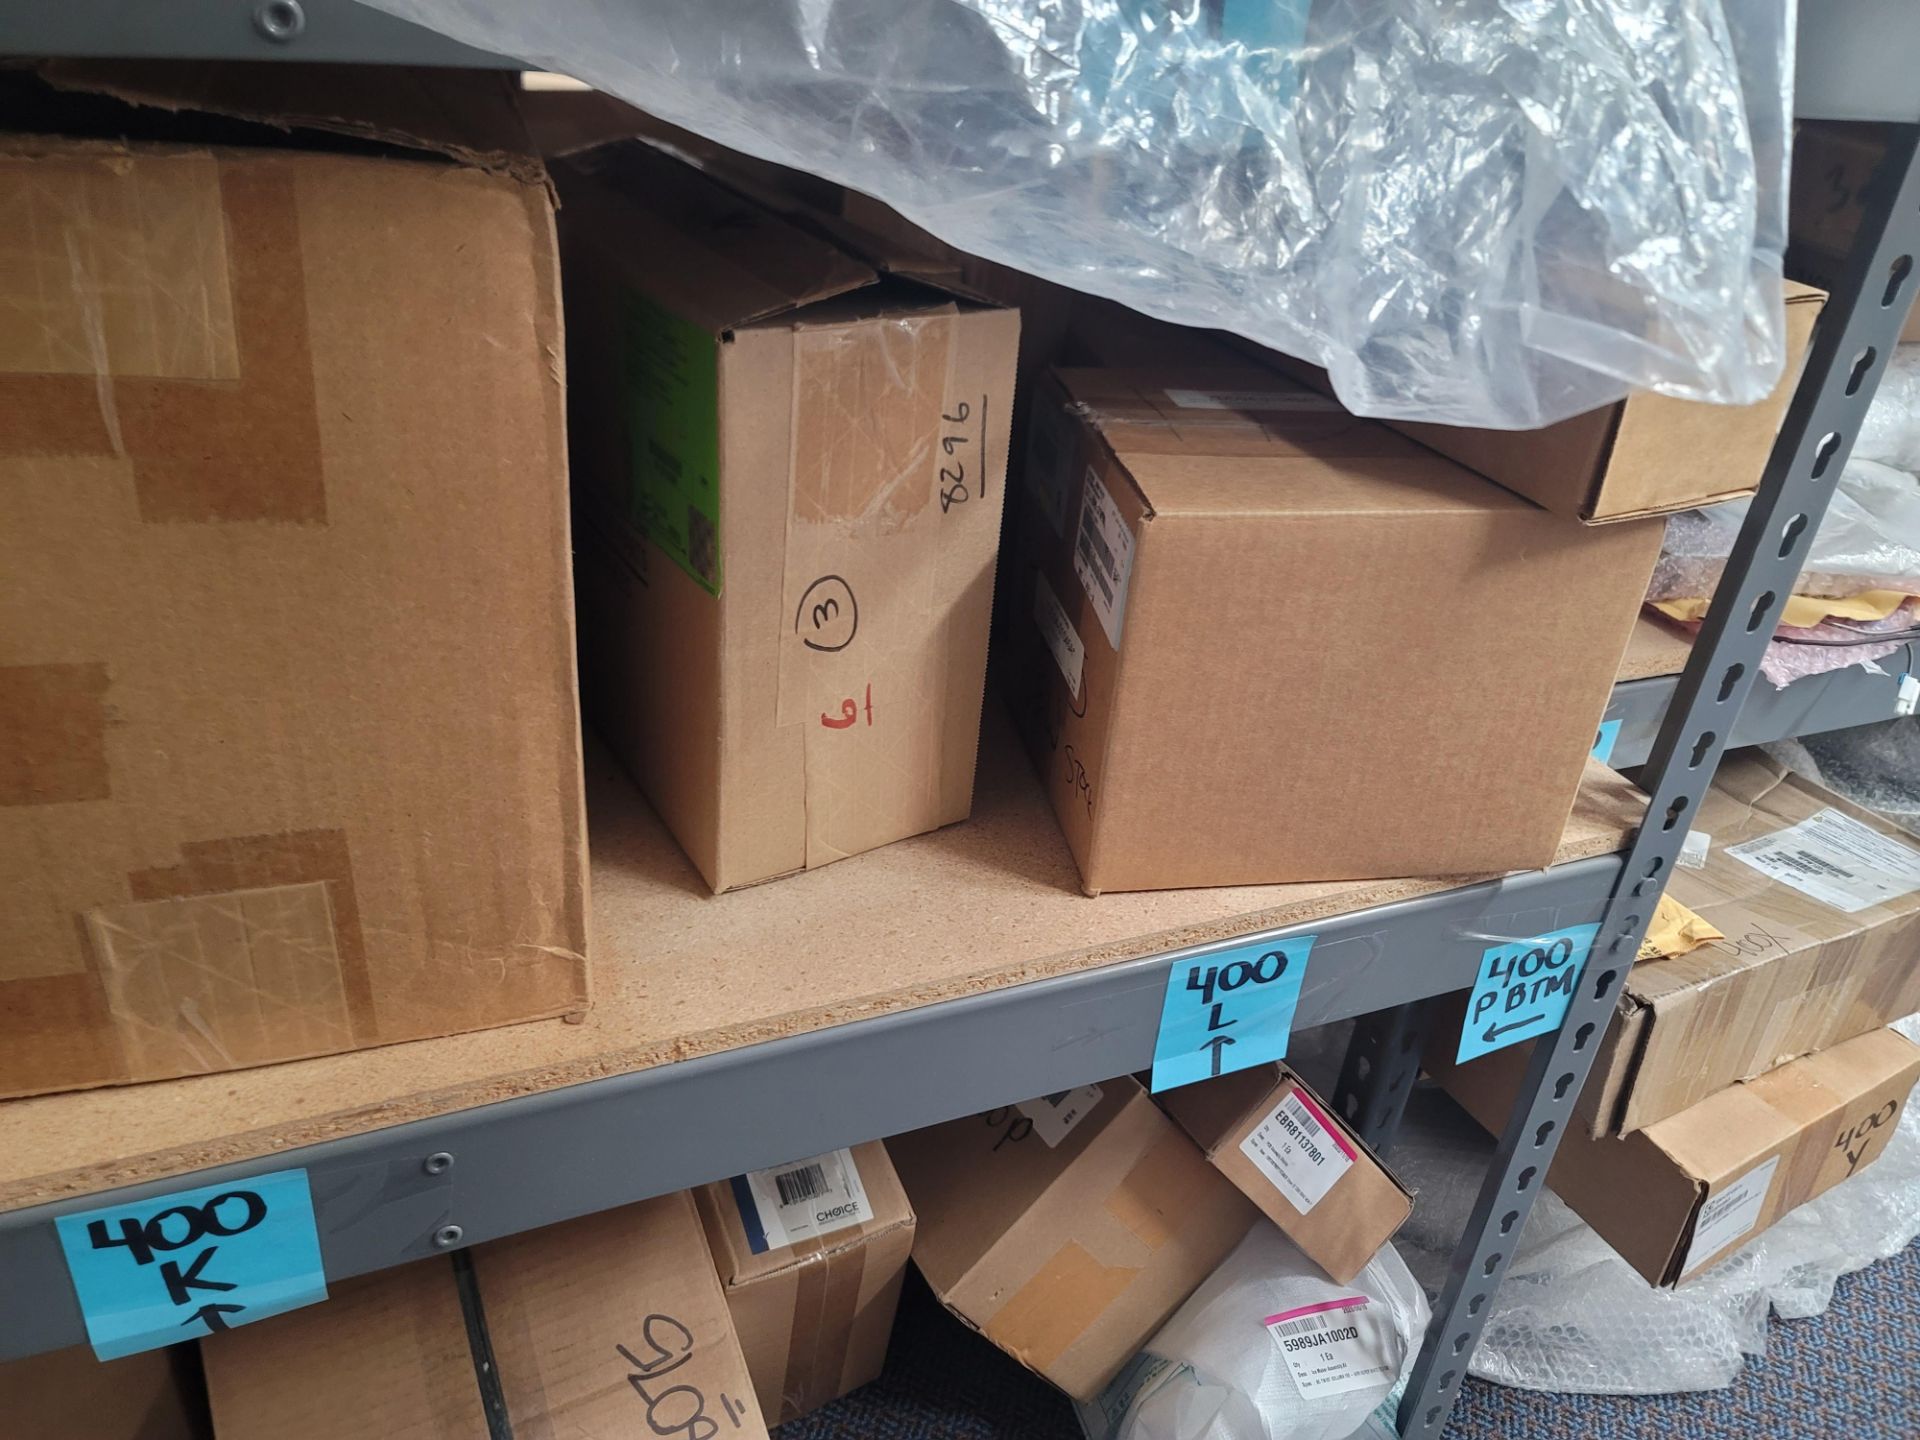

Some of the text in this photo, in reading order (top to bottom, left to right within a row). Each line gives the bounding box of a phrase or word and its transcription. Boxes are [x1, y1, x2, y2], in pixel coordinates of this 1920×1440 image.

[940, 401, 970, 514] 8296
[812, 597, 840, 630] 3
[1185, 950, 1289, 1005] 400
[1487, 937, 1574, 989] 400
[1207, 1002, 1239, 1032] L
[1472, 963, 1576, 1026] P BTM
[1274, 1109, 1327, 1167] EBR81137801
[1834, 1099, 1898, 1153] 400
[1846, 1138, 1871, 1178] Y
[86, 1190, 268, 1266] 400
[816, 1200, 860, 1222] CHOICE
[159, 1245, 239, 1306] K
[1283, 1326, 1359, 1352] 5989JA1002D
